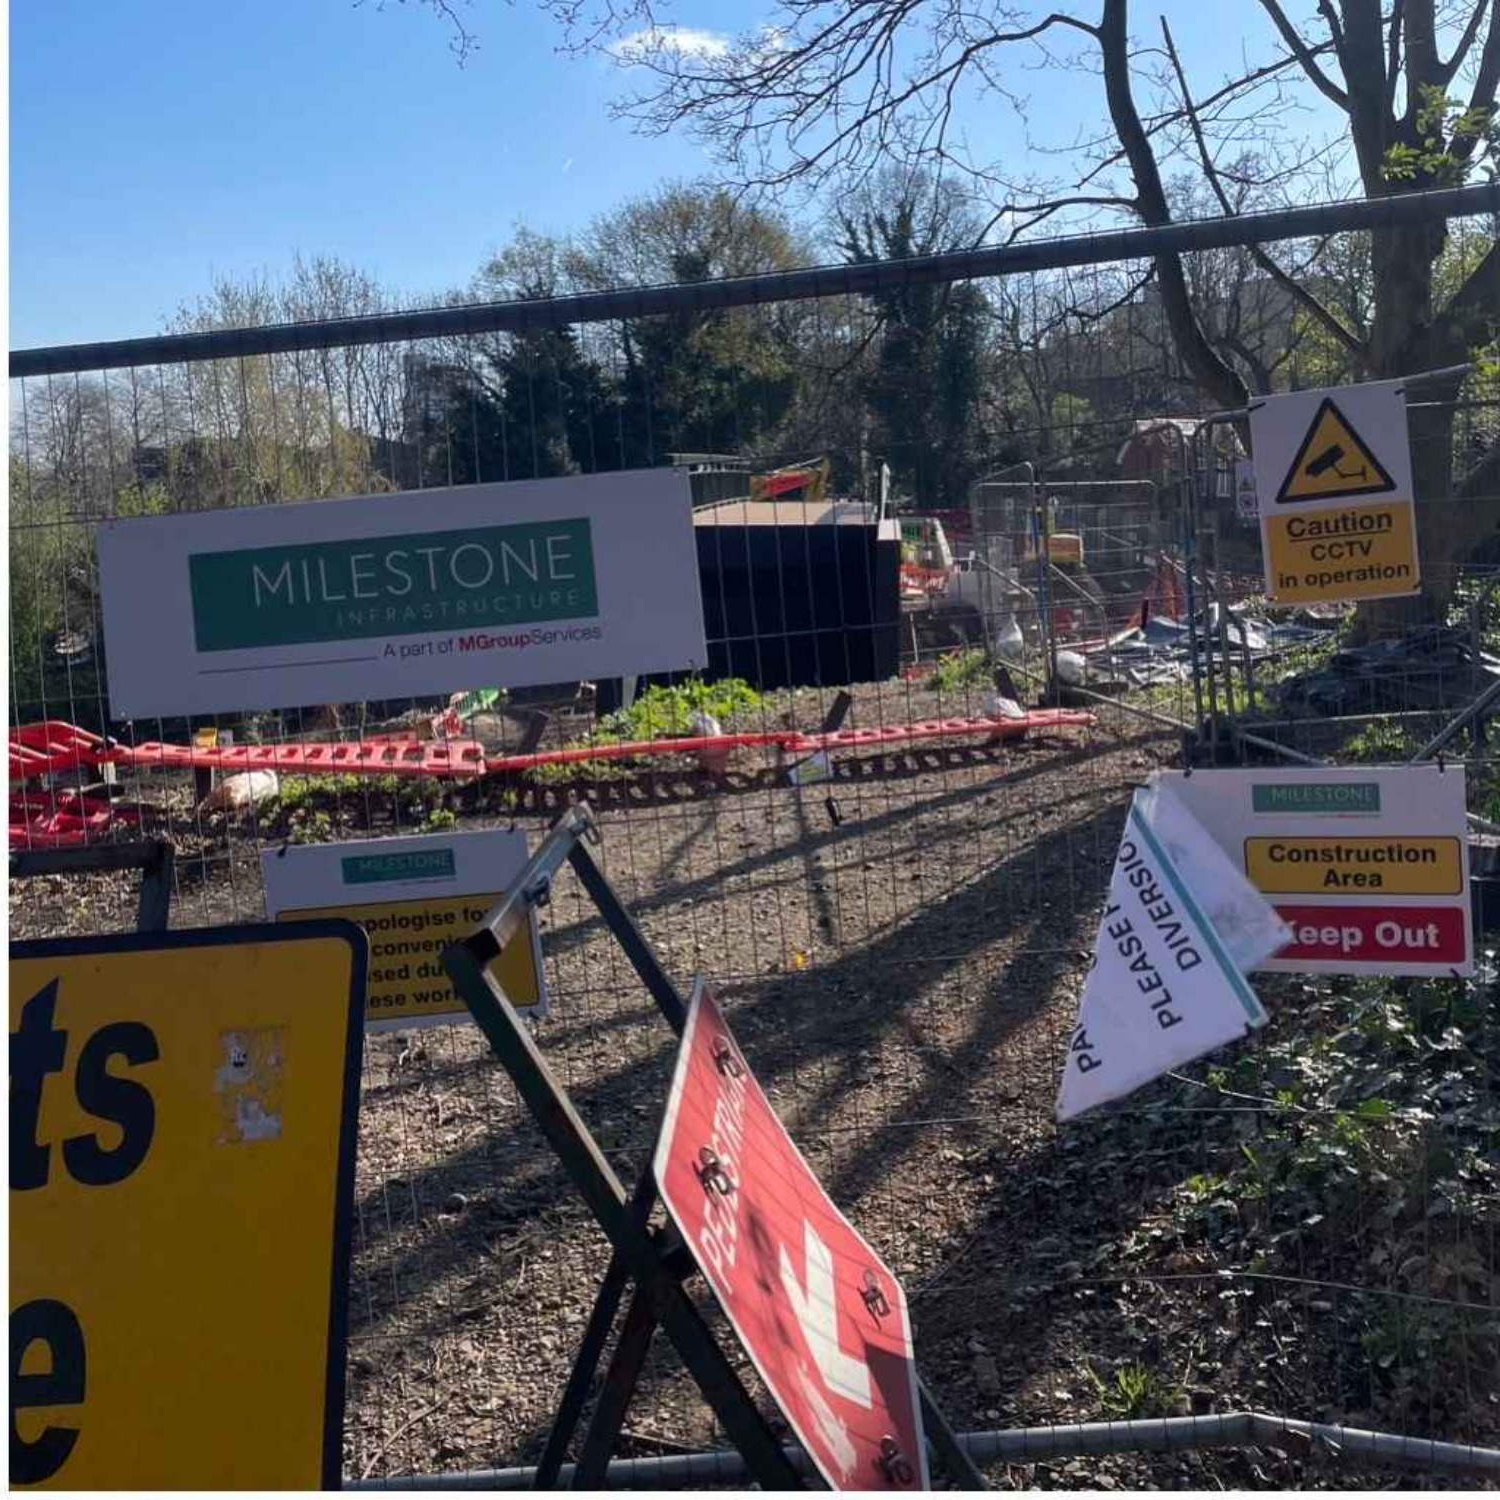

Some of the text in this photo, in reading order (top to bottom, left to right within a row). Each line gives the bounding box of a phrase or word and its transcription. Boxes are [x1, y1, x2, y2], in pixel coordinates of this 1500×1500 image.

[1287, 511, 1393, 539] Caution
[1310, 539, 1372, 562] CCTV
[252, 534, 577, 608] MILESTONE
[1278, 563, 1410, 589] in operation
[337, 588, 578, 628] INFRASTRUCTURE
[383, 626, 602, 662] A part of MGroupServices
[1271, 785, 1373, 802] MILESTONE
[1268, 842, 1437, 865] Construction
[1323, 868, 1383, 888] Area
[1118, 835, 1203, 972] DIVERSIO
[1375, 921, 1440, 950] Out
[1107, 917, 1184, 1030] PLEASE
